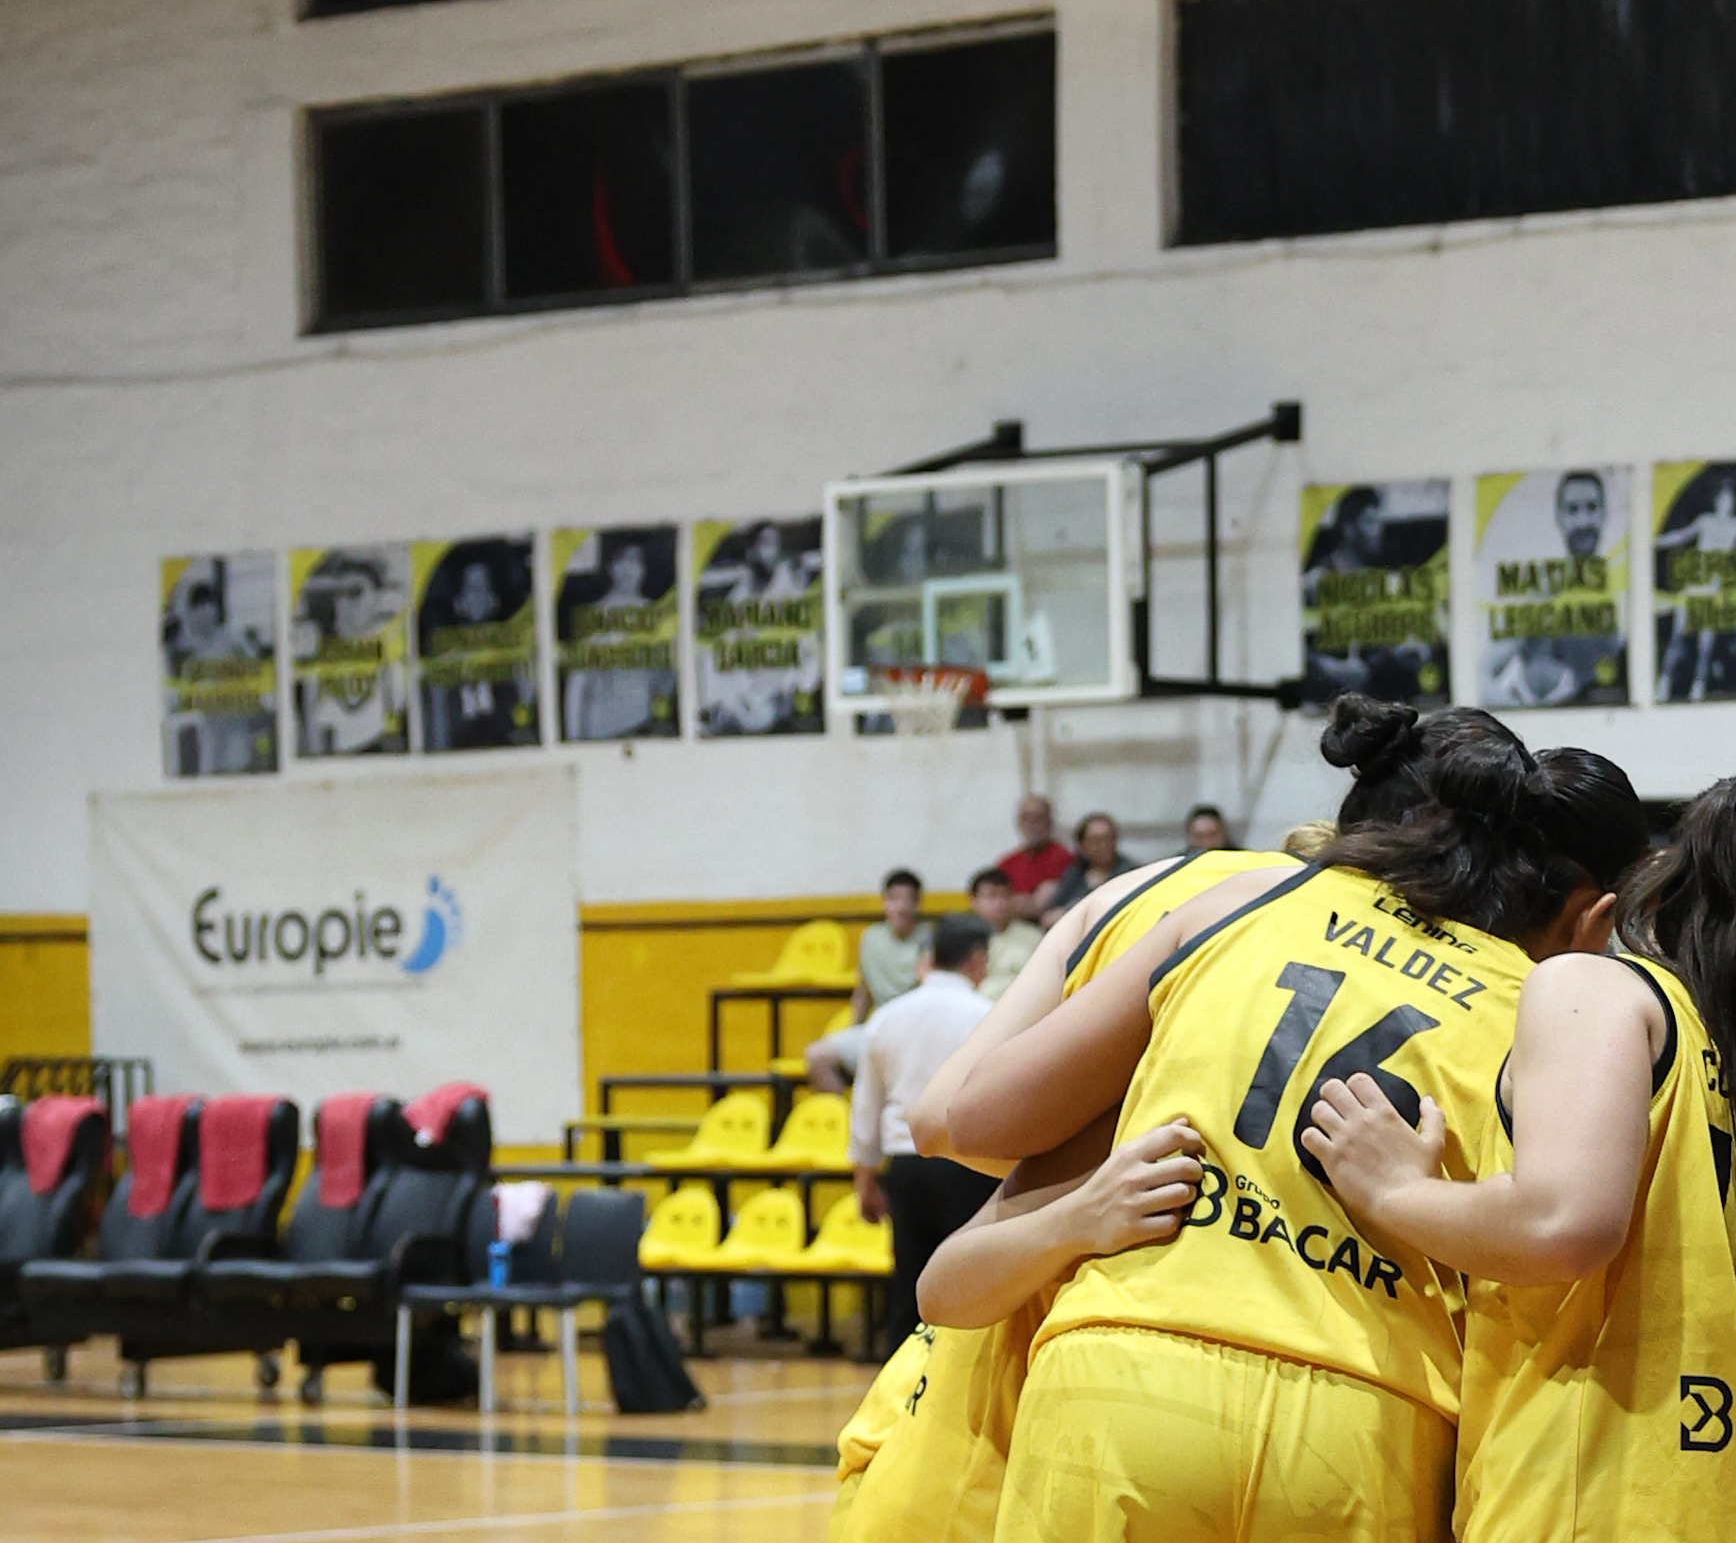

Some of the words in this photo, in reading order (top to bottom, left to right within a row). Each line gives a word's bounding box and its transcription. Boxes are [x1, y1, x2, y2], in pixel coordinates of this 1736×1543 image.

[192, 887, 402, 975] Europie
[1325, 911, 1487, 1011] VALDEZ
[1233, 961, 1441, 1184] 16
[1235, 1174, 1280, 1210] Grupo
[1229, 1196, 1403, 1299] BACAR
